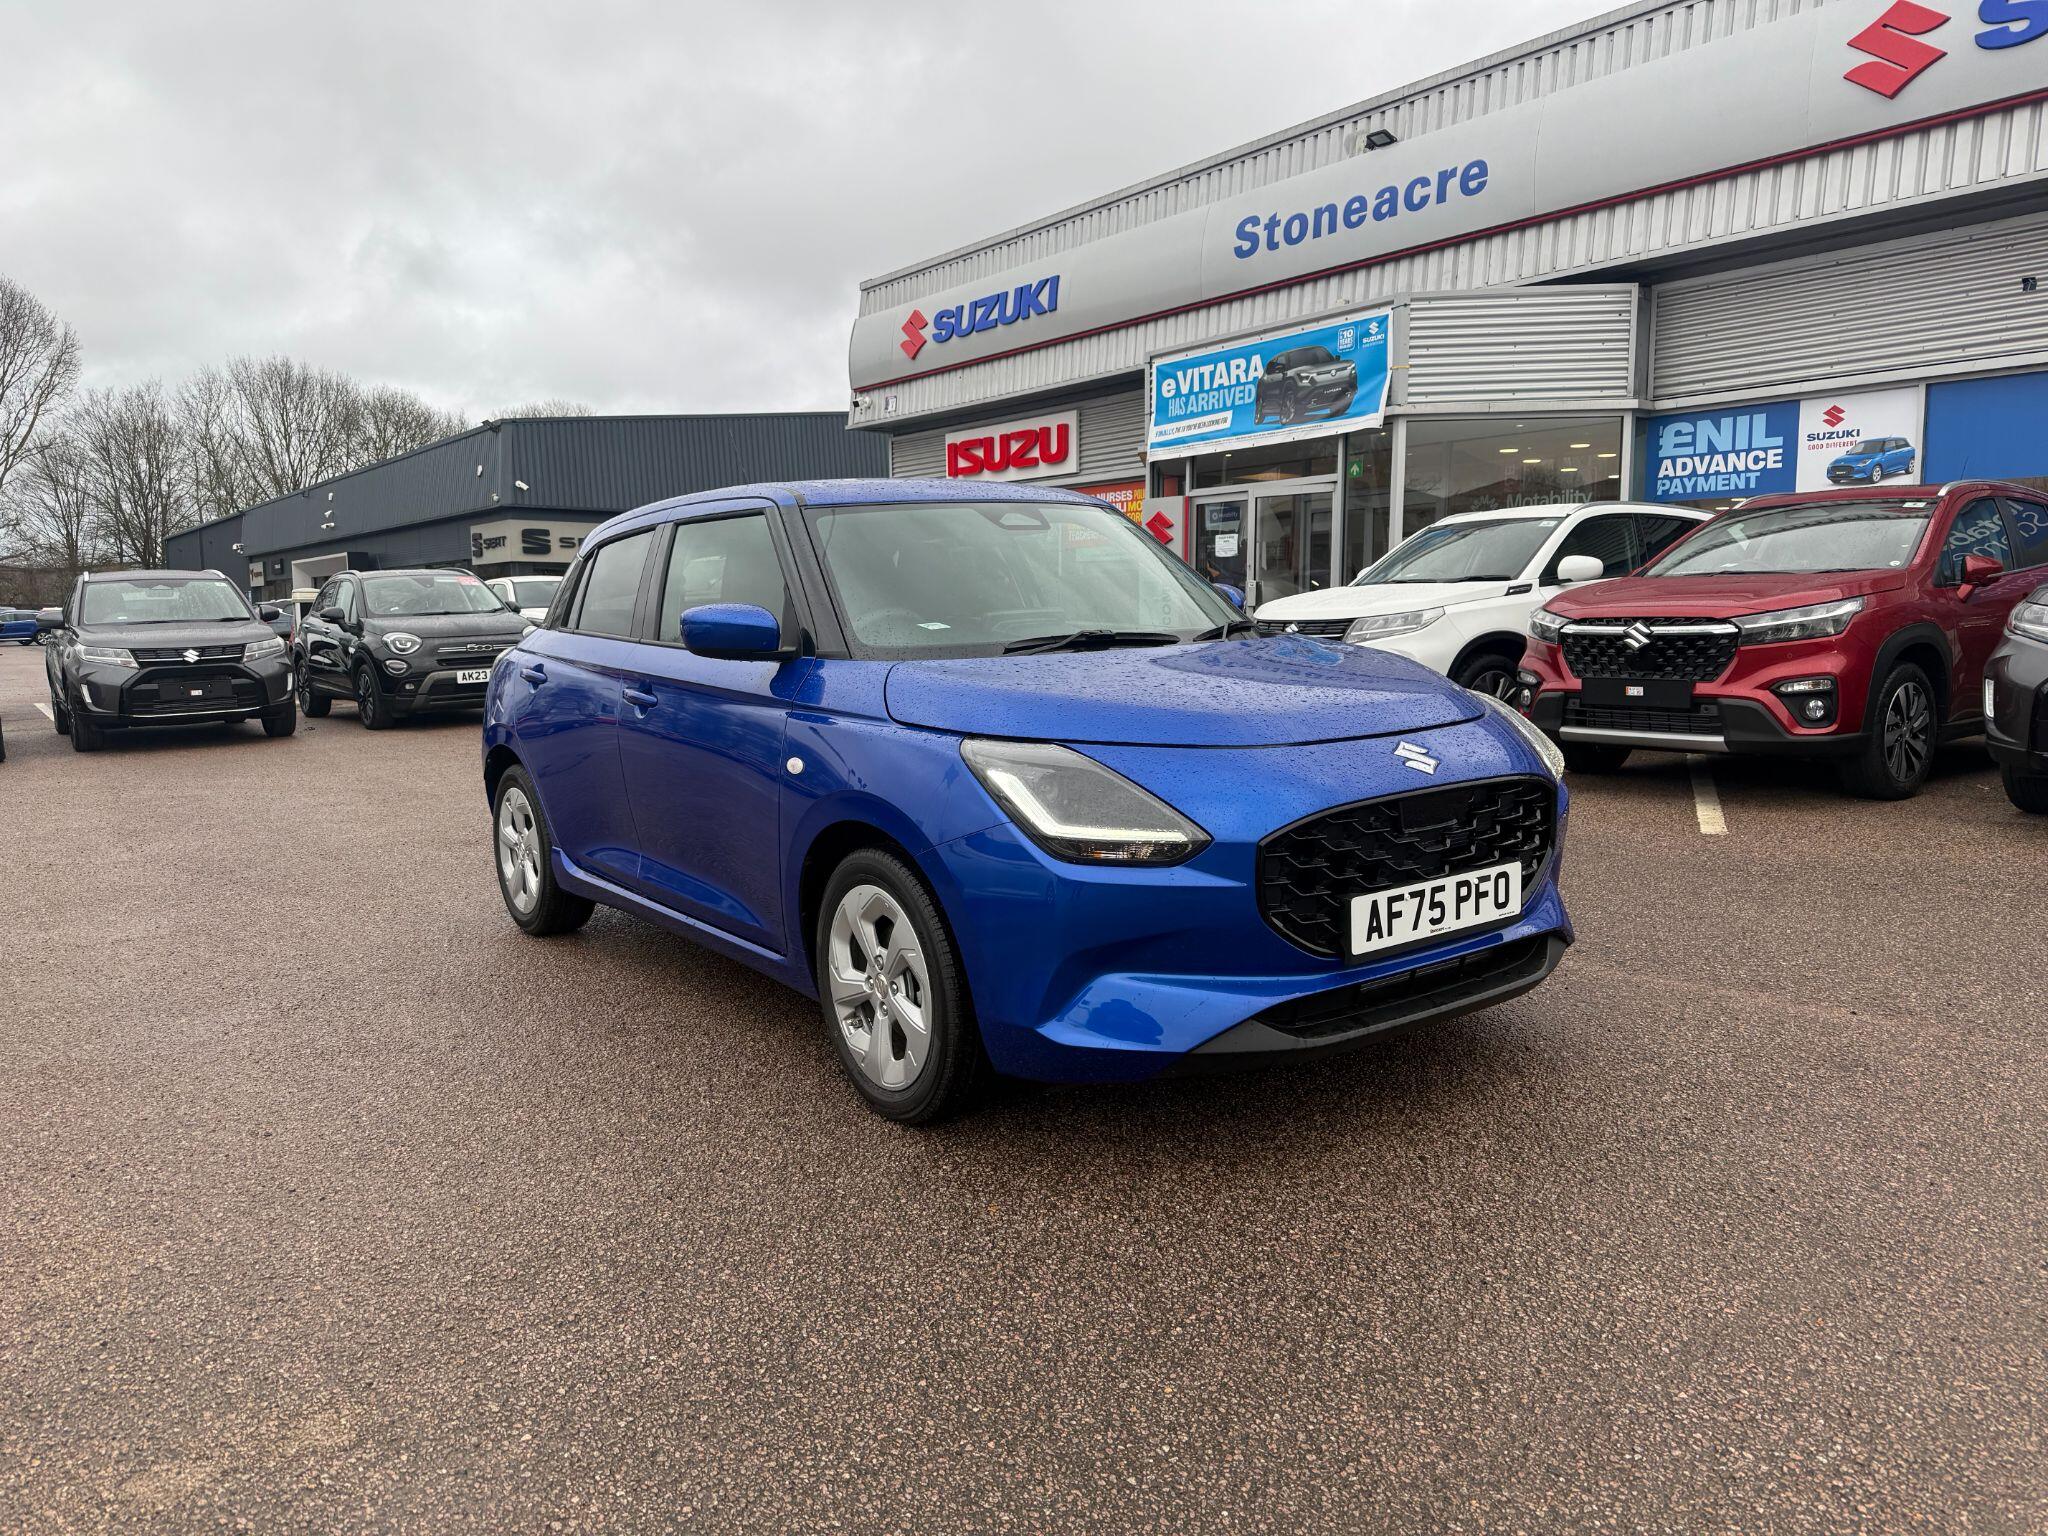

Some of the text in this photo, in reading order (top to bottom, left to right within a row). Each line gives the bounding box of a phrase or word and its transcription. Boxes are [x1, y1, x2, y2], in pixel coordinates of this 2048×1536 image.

[1233, 159, 1489, 260] Stoneacre
[932, 275, 1060, 343] SUZUKI
[1363, 333, 1384, 343] SUZUKI
[1168, 384, 1256, 417] HAS ARRIVED
[1659, 413, 1783, 457] £NIL
[1807, 429, 1860, 442] SUZUKI
[1808, 440, 1857, 451] GOOD DIFFERENT
[947, 423, 1070, 478] ISUZU
[1658, 449, 1783, 478] ADVANCE
[1657, 472, 1760, 495] PAYMENT
[483, 536, 507, 549] SEAT
[461, 671, 488, 682] AK23
[1366, 871, 1510, 942] AF75 PFO
